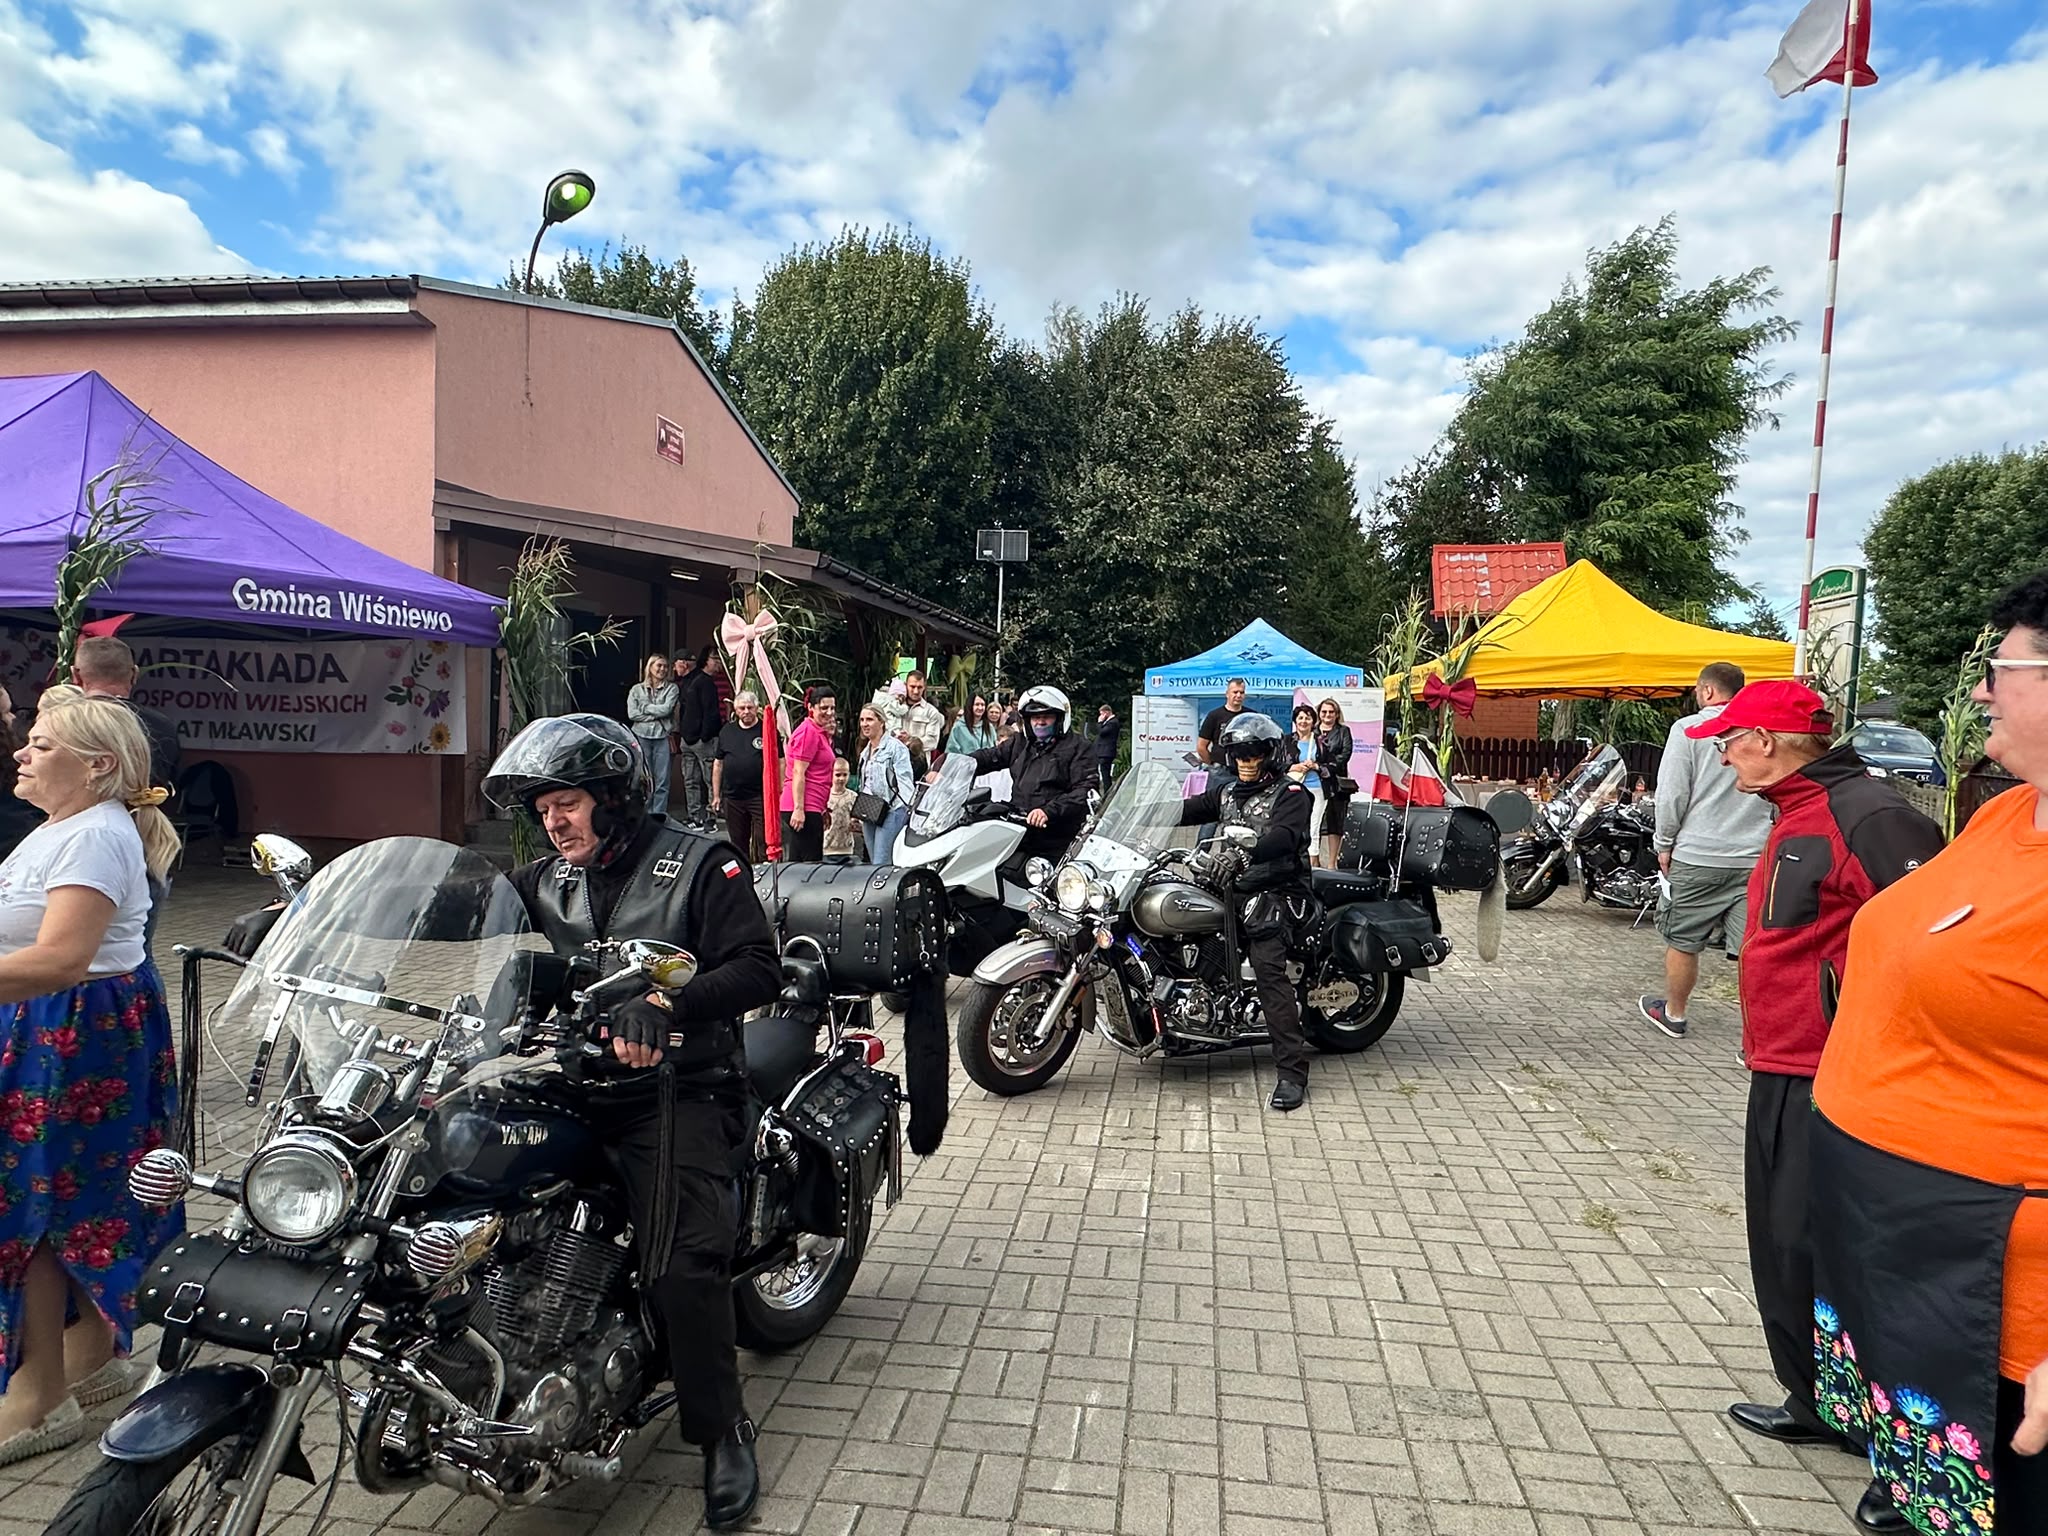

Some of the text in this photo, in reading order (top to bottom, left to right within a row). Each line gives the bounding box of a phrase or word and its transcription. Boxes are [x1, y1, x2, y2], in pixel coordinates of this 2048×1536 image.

[232, 577, 453, 632] Gmina Wiśniewo
[131, 647, 349, 684] ARTAKIADA
[1168, 677, 1261, 688] STOWARZYSNIE
[1264, 678, 1297, 690] JOKER
[131, 689, 368, 714] OSPODYN WIEJSKICH
[177, 719, 316, 742] AT MŁAWSKI
